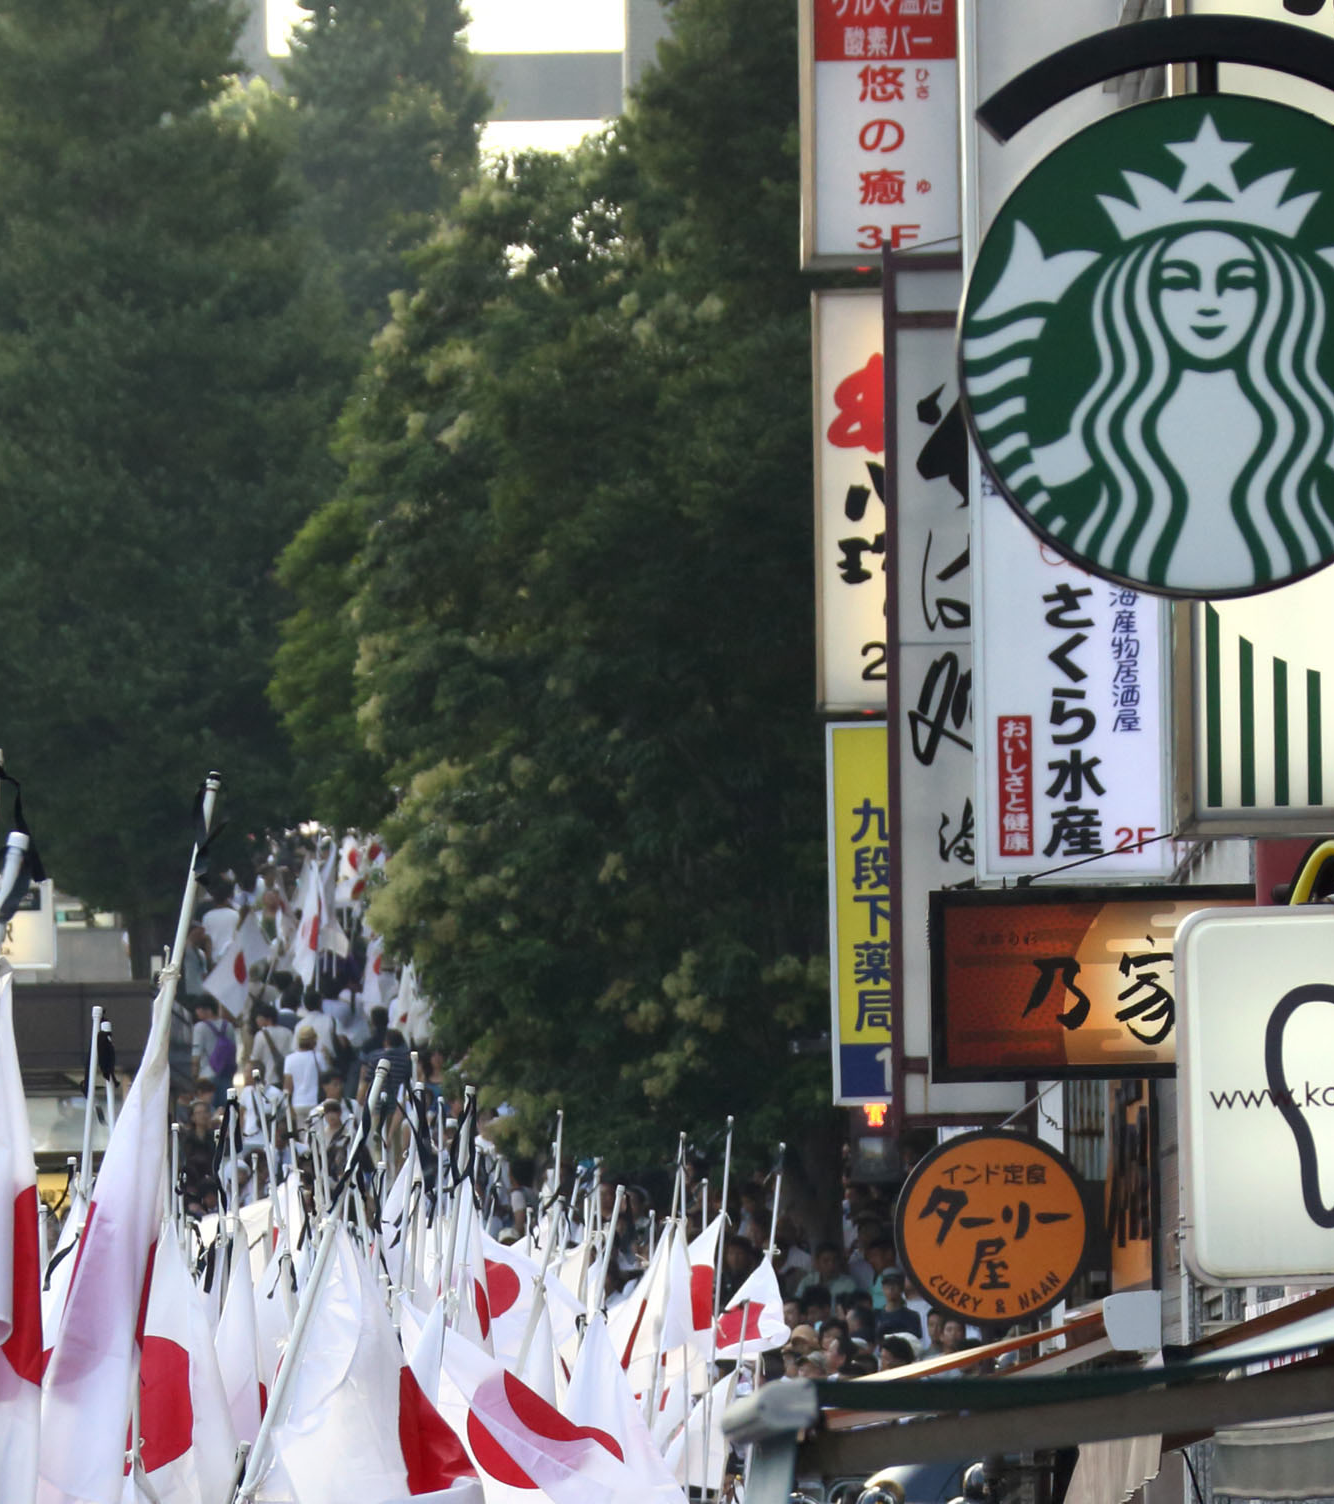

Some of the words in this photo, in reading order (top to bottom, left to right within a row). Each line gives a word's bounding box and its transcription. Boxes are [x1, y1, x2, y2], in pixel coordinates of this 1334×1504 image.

[844, 26, 933, 56] 酸素バー
[858, 64, 905, 205] 悠の癒
[857, 225, 921, 250] 3F
[1042, 583, 1106, 859] さくら水産
[1001, 719, 1032, 853] おいしさと健康
[1114, 826, 1157, 854] 2F
[942, 1162, 1047, 1186] インド定食
[918, 1185, 1072, 1248] ターリー
[968, 1236, 1010, 1290] 屋
[928, 1273, 982, 1313] CURRY
[995, 1298, 1006, 1314] &
[1019, 1270, 1061, 1311] NAAN
